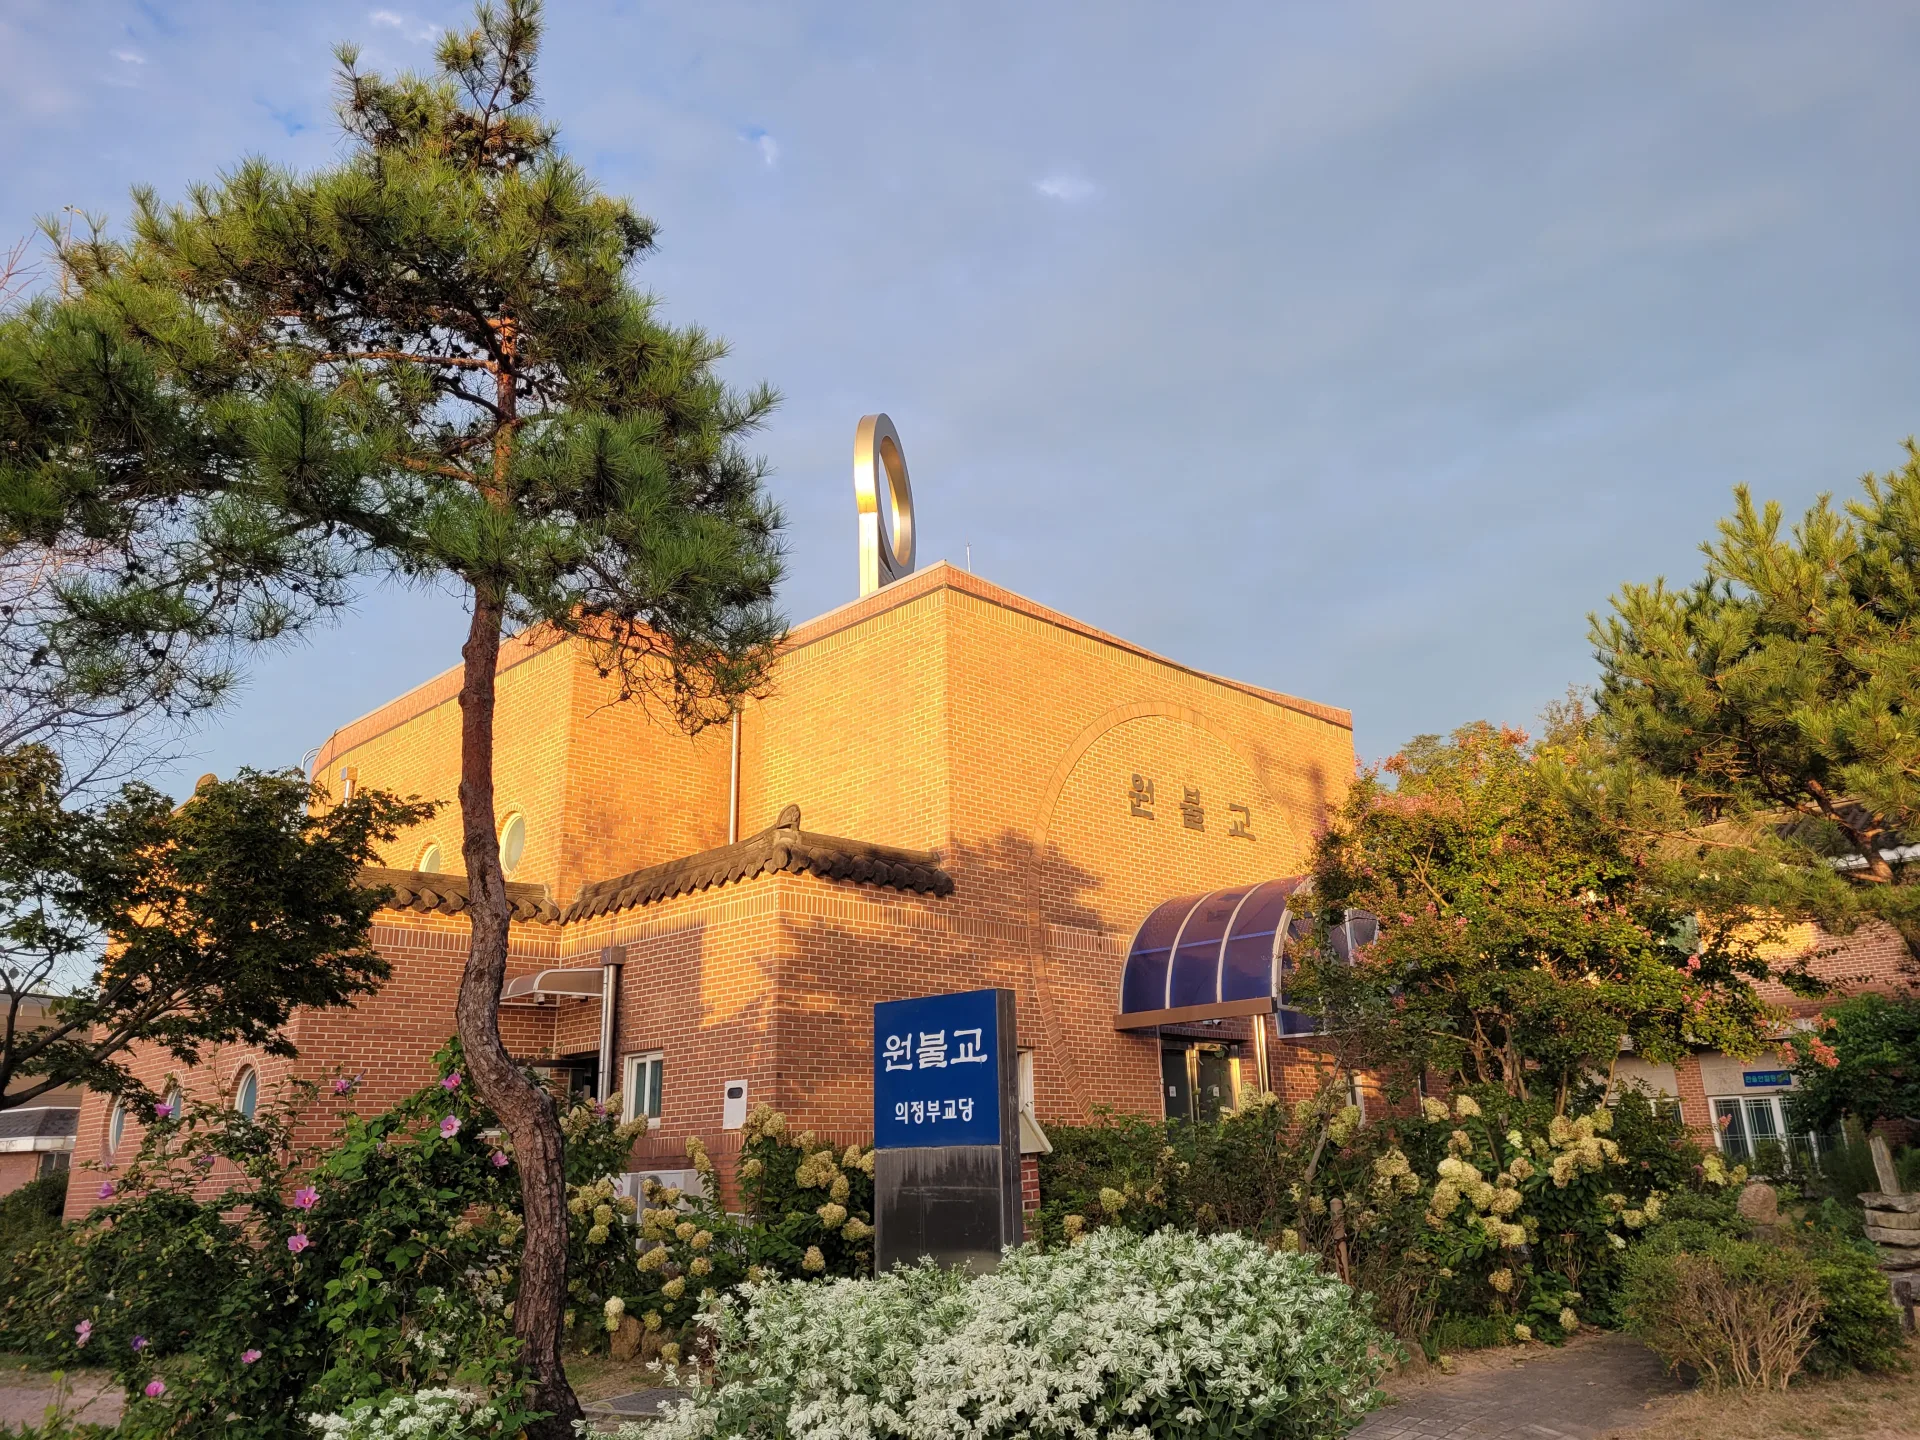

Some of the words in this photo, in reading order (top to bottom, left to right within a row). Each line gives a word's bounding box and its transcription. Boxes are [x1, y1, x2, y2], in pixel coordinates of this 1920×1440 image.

[1128, 773, 1256, 841] 원불교
[882, 1028, 988, 1072] 원불교
[895, 1098, 974, 1124] 의정부교당
